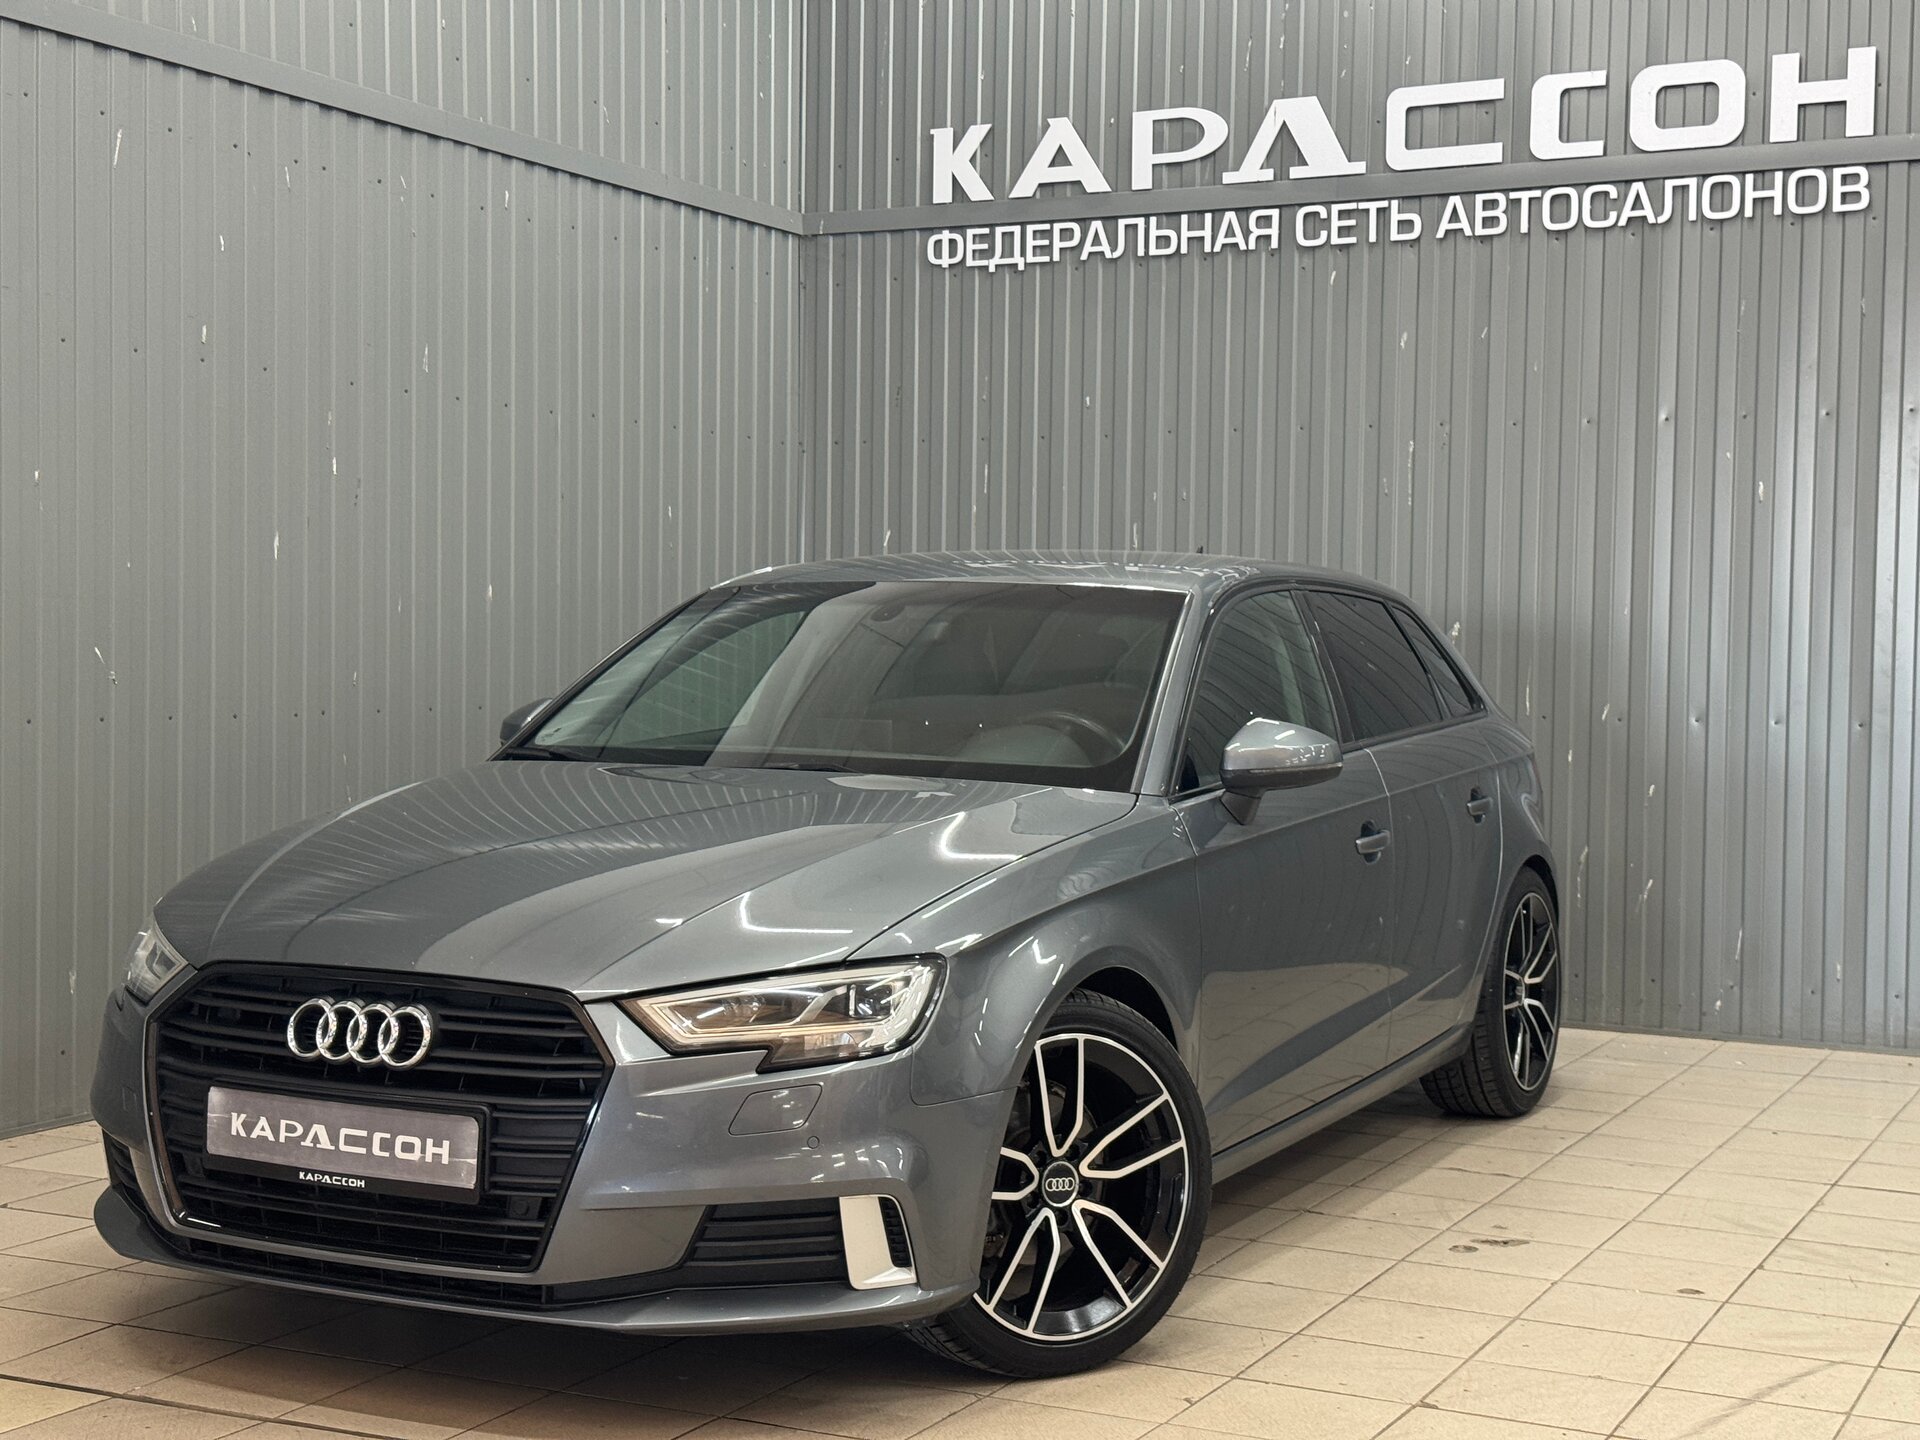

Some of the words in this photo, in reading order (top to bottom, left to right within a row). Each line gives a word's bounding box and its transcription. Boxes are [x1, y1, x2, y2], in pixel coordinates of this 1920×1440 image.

[926, 208, 1280, 272] ФЕДЕРАЛЬНАЯ
[1295, 199, 1423, 247] СЕТЬ
[1436, 166, 1871, 239] АВТОСАЛОНОВ
